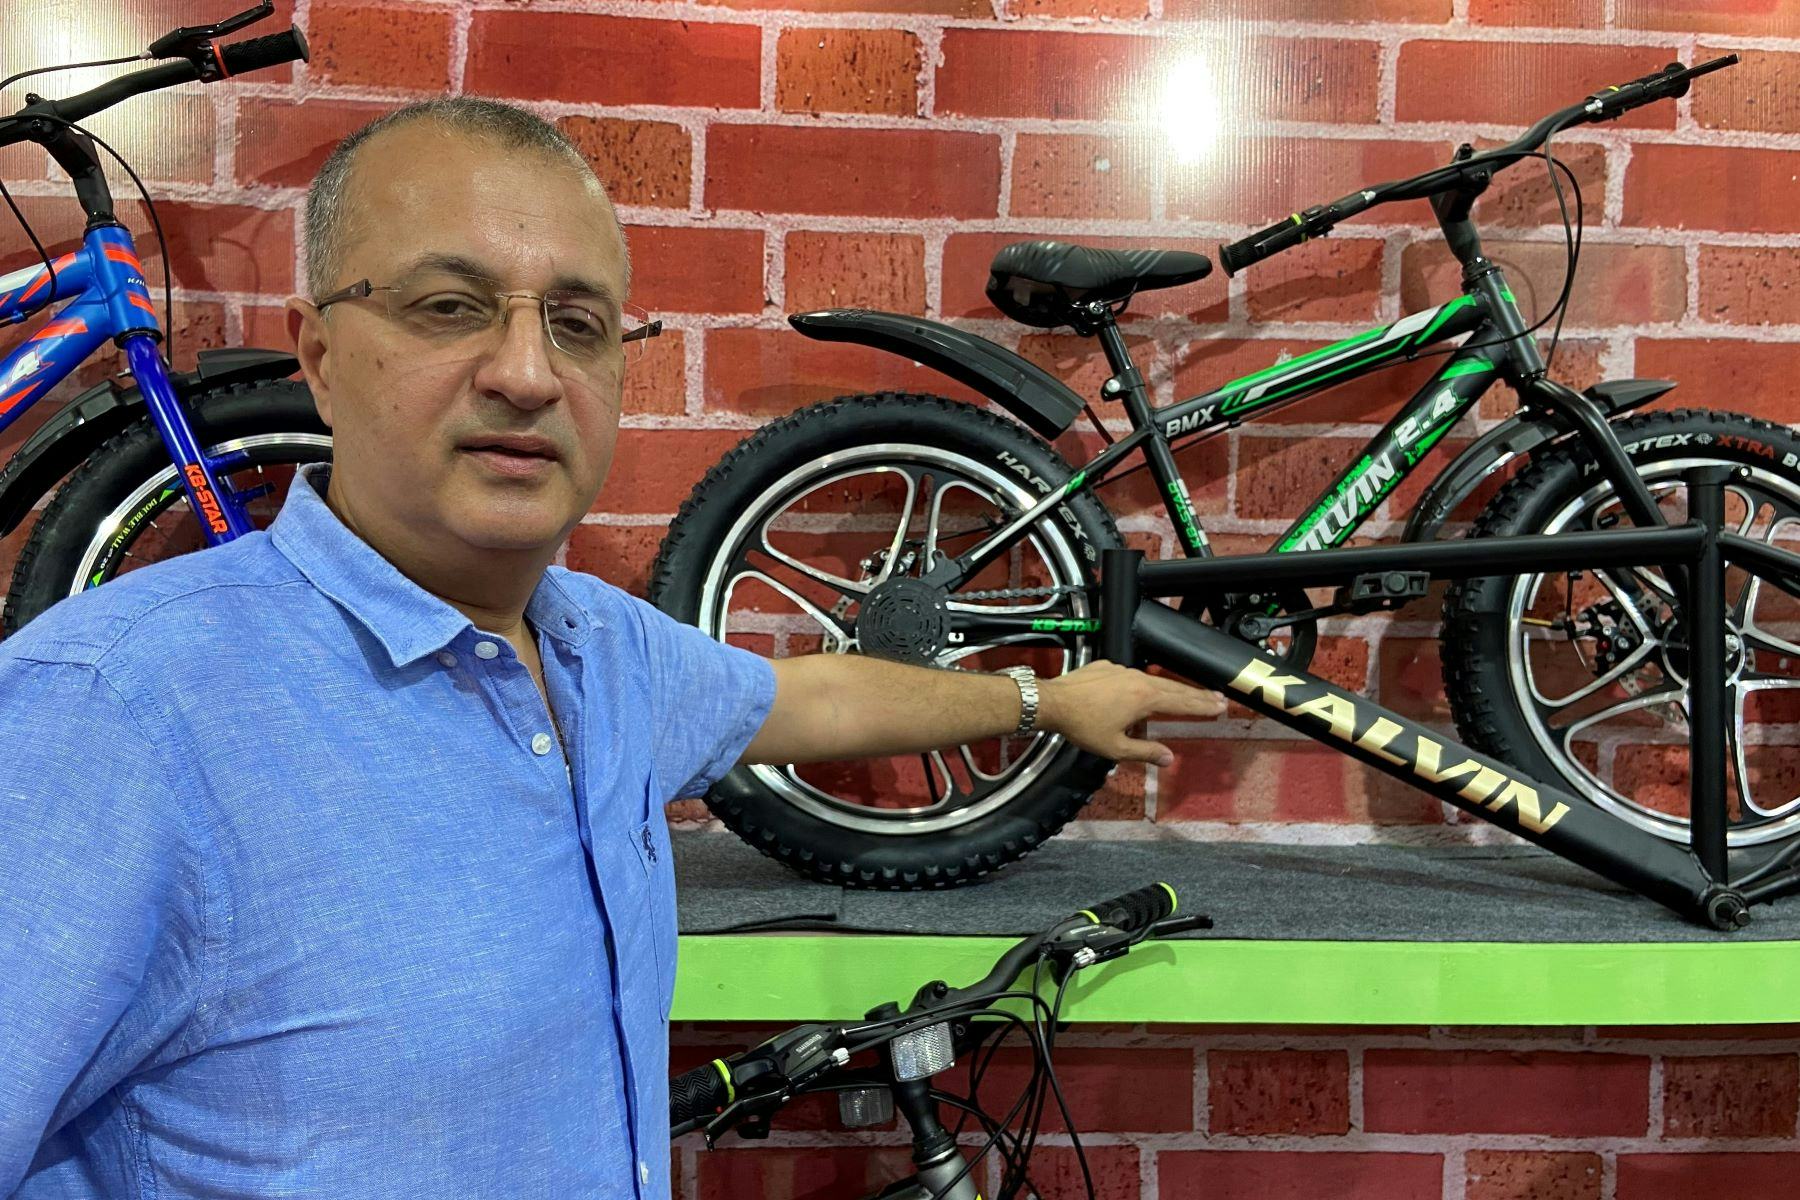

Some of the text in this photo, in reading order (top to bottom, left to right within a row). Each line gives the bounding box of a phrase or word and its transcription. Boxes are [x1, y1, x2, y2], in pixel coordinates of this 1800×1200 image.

[1166, 405, 1215, 438] BMX
[1716, 433, 1775, 460] XTRA
[184, 464, 228, 534] KB-STAR
[996, 451, 1088, 540] HAREX
[1295, 388, 1458, 551] ALVIN 2.4
[112, 525, 131, 549] WALL
[130, 498, 158, 528] DOUBLE
[1168, 480, 1201, 549] KB-STAR
[1228, 658, 1570, 835] KALVIN
